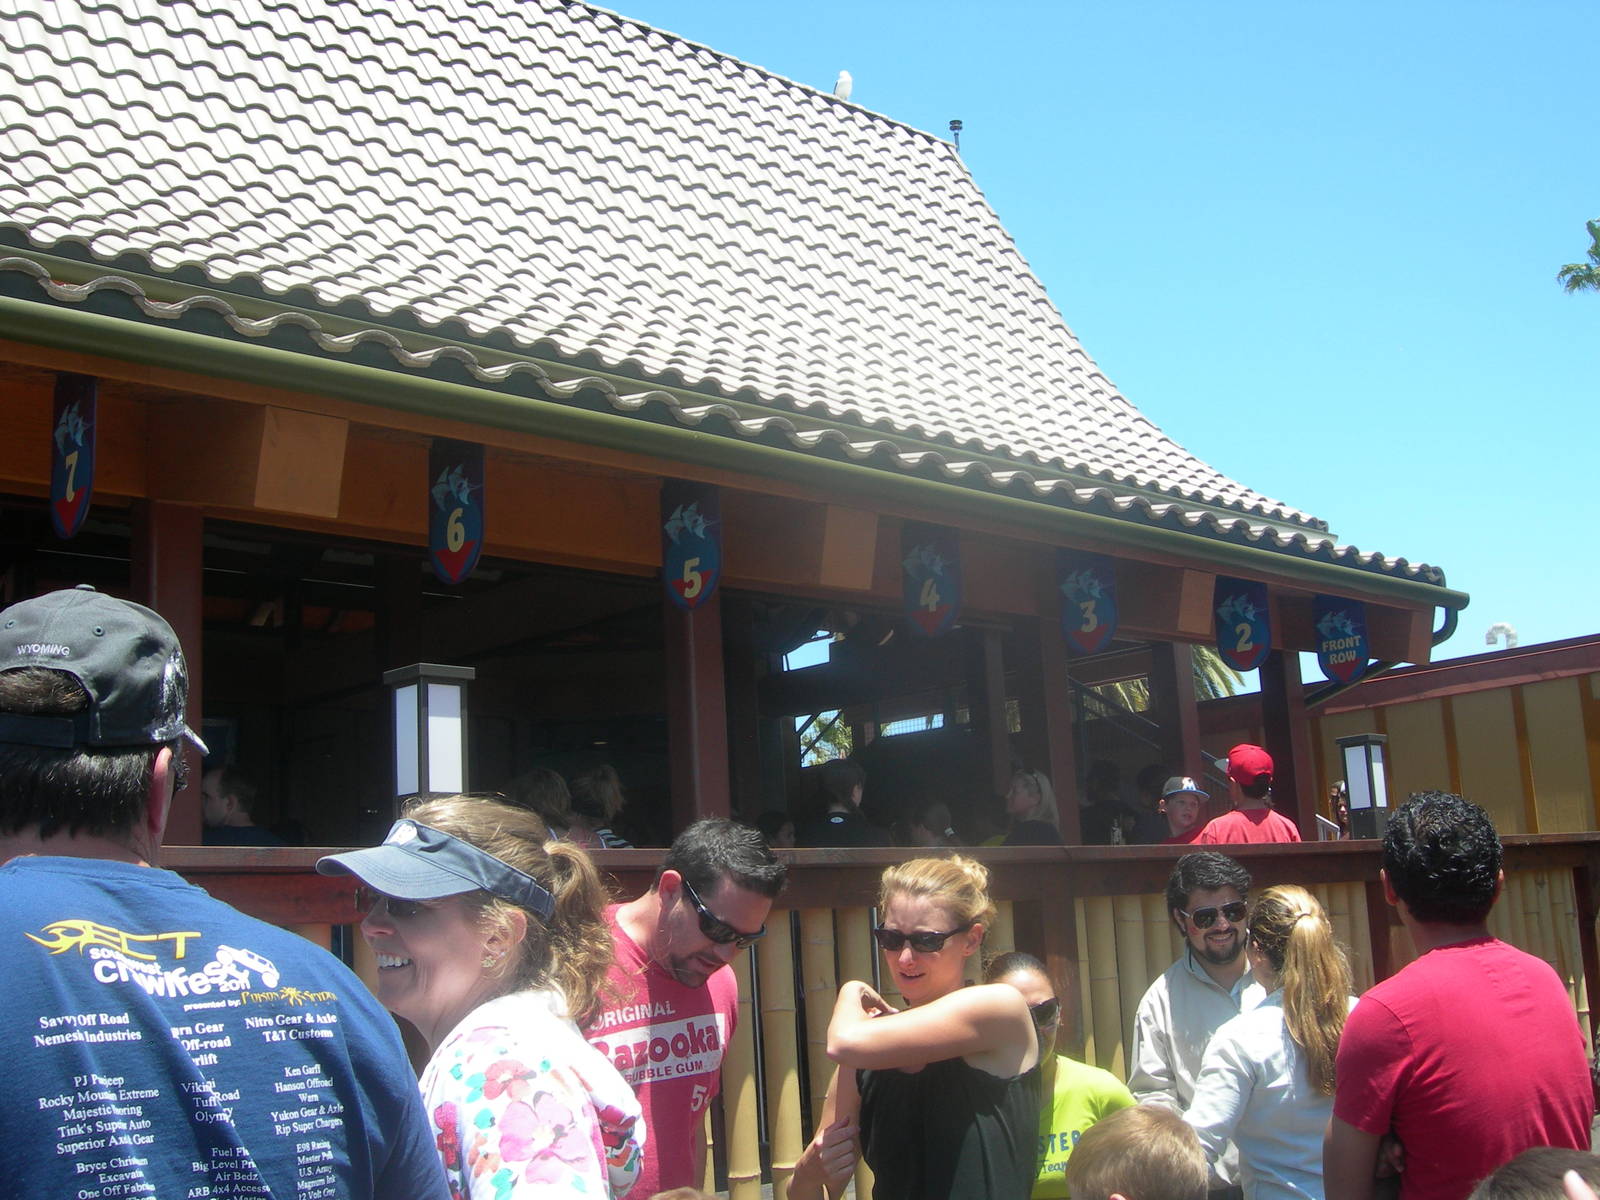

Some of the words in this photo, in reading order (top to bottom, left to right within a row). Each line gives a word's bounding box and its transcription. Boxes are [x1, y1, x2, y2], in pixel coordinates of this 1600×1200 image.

[65, 450, 79, 503] 7
[446, 507, 466, 553] 6
[683, 556, 702, 599] 5
[919, 577, 940, 613] 4
[1079, 599, 1098, 633] 3
[1234, 622, 1254, 653] 2
[1321, 634, 1362, 652] FRONT
[16, 643, 71, 657] WYOMING
[1328, 650, 1358, 665] ROW
[78, 1013, 97, 1026] Off
[99, 1012, 130, 1026] Road
[244, 1015, 274, 1030] Nitro
[275, 1014, 303, 1026] Gear
[305, 1012, 315, 1023] &
[84, 1029, 142, 1043] Industries
[194, 1021, 225, 1035] Gear
[262, 1029, 288, 1043] T&T
[284, 1066, 302, 1078] Ken
[675, 1059, 704, 1075] GUM
[274, 1081, 306, 1094] Hanson
[38, 1094, 75, 1110] Rocky
[118, 1088, 160, 1102] Extreme
[63, 1103, 112, 1122] Majestic
[270, 1109, 300, 1123] Yukon
[300, 1107, 318, 1119] Gear
[318, 1104, 326, 1115] &
[57, 1121, 94, 1138] Tink's
[128, 1118, 152, 1131] Auto
[274, 1122, 292, 1137] Rip
[291, 1120, 316, 1135] Super
[56, 1136, 106, 1155] Superior
[132, 1132, 155, 1146] Gear
[211, 1146, 233, 1158] Fuel
[76, 1160, 108, 1175] Bryce
[192, 1160, 210, 1173] Big
[211, 1159, 239, 1170] Level
[215, 1172, 231, 1182] Air
[232, 1170, 259, 1182] Bedz
[78, 1188, 101, 1200] One
[102, 1184, 122, 1197] Off
[187, 1185, 211, 1199] ARB
[212, 1183, 231, 1195] 4x4
